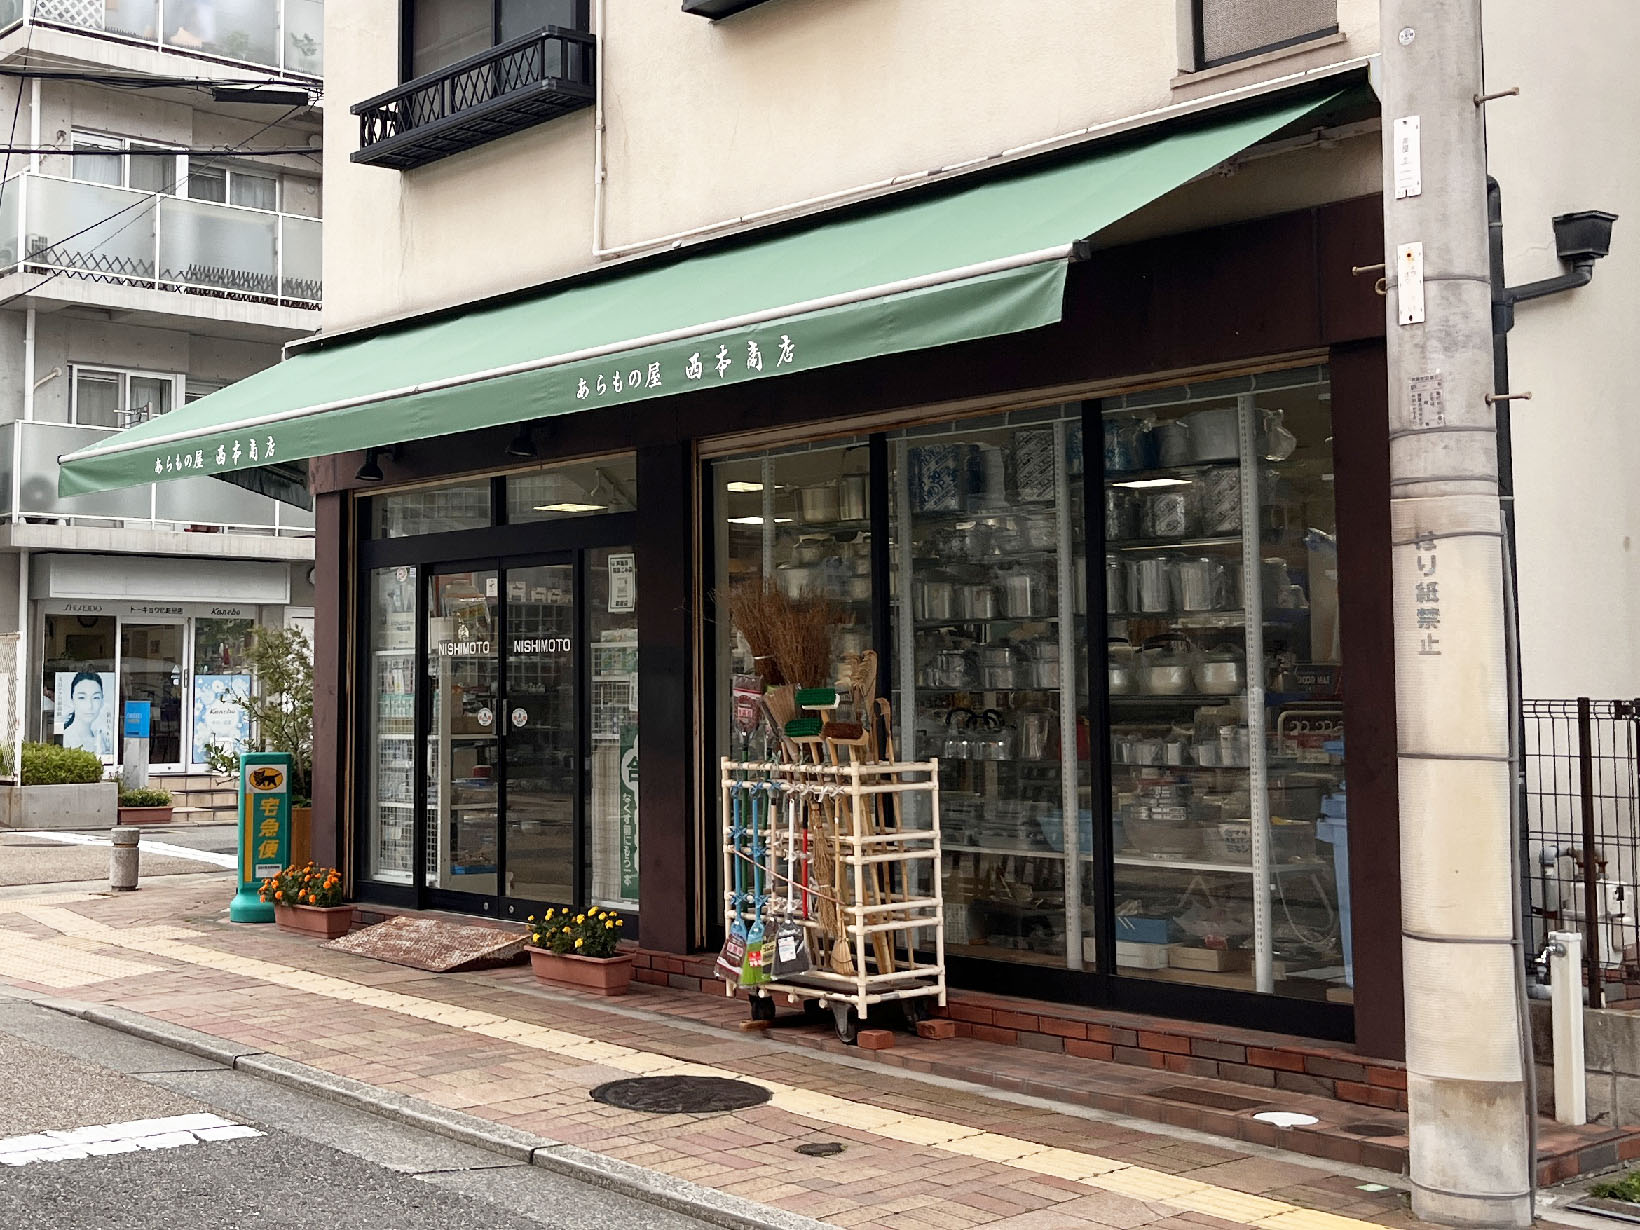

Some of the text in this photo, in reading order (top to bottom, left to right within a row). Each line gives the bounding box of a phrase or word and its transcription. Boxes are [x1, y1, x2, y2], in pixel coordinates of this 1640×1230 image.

[576, 334, 795, 400] あらもの屋 西本商店
[154, 435, 276, 474] あらもの屋 西本商店
[438, 640, 490, 656] NISHIMOTO
[513, 638, 571, 653] NISHIMOTO
[258, 797, 280, 860] 宅急便
